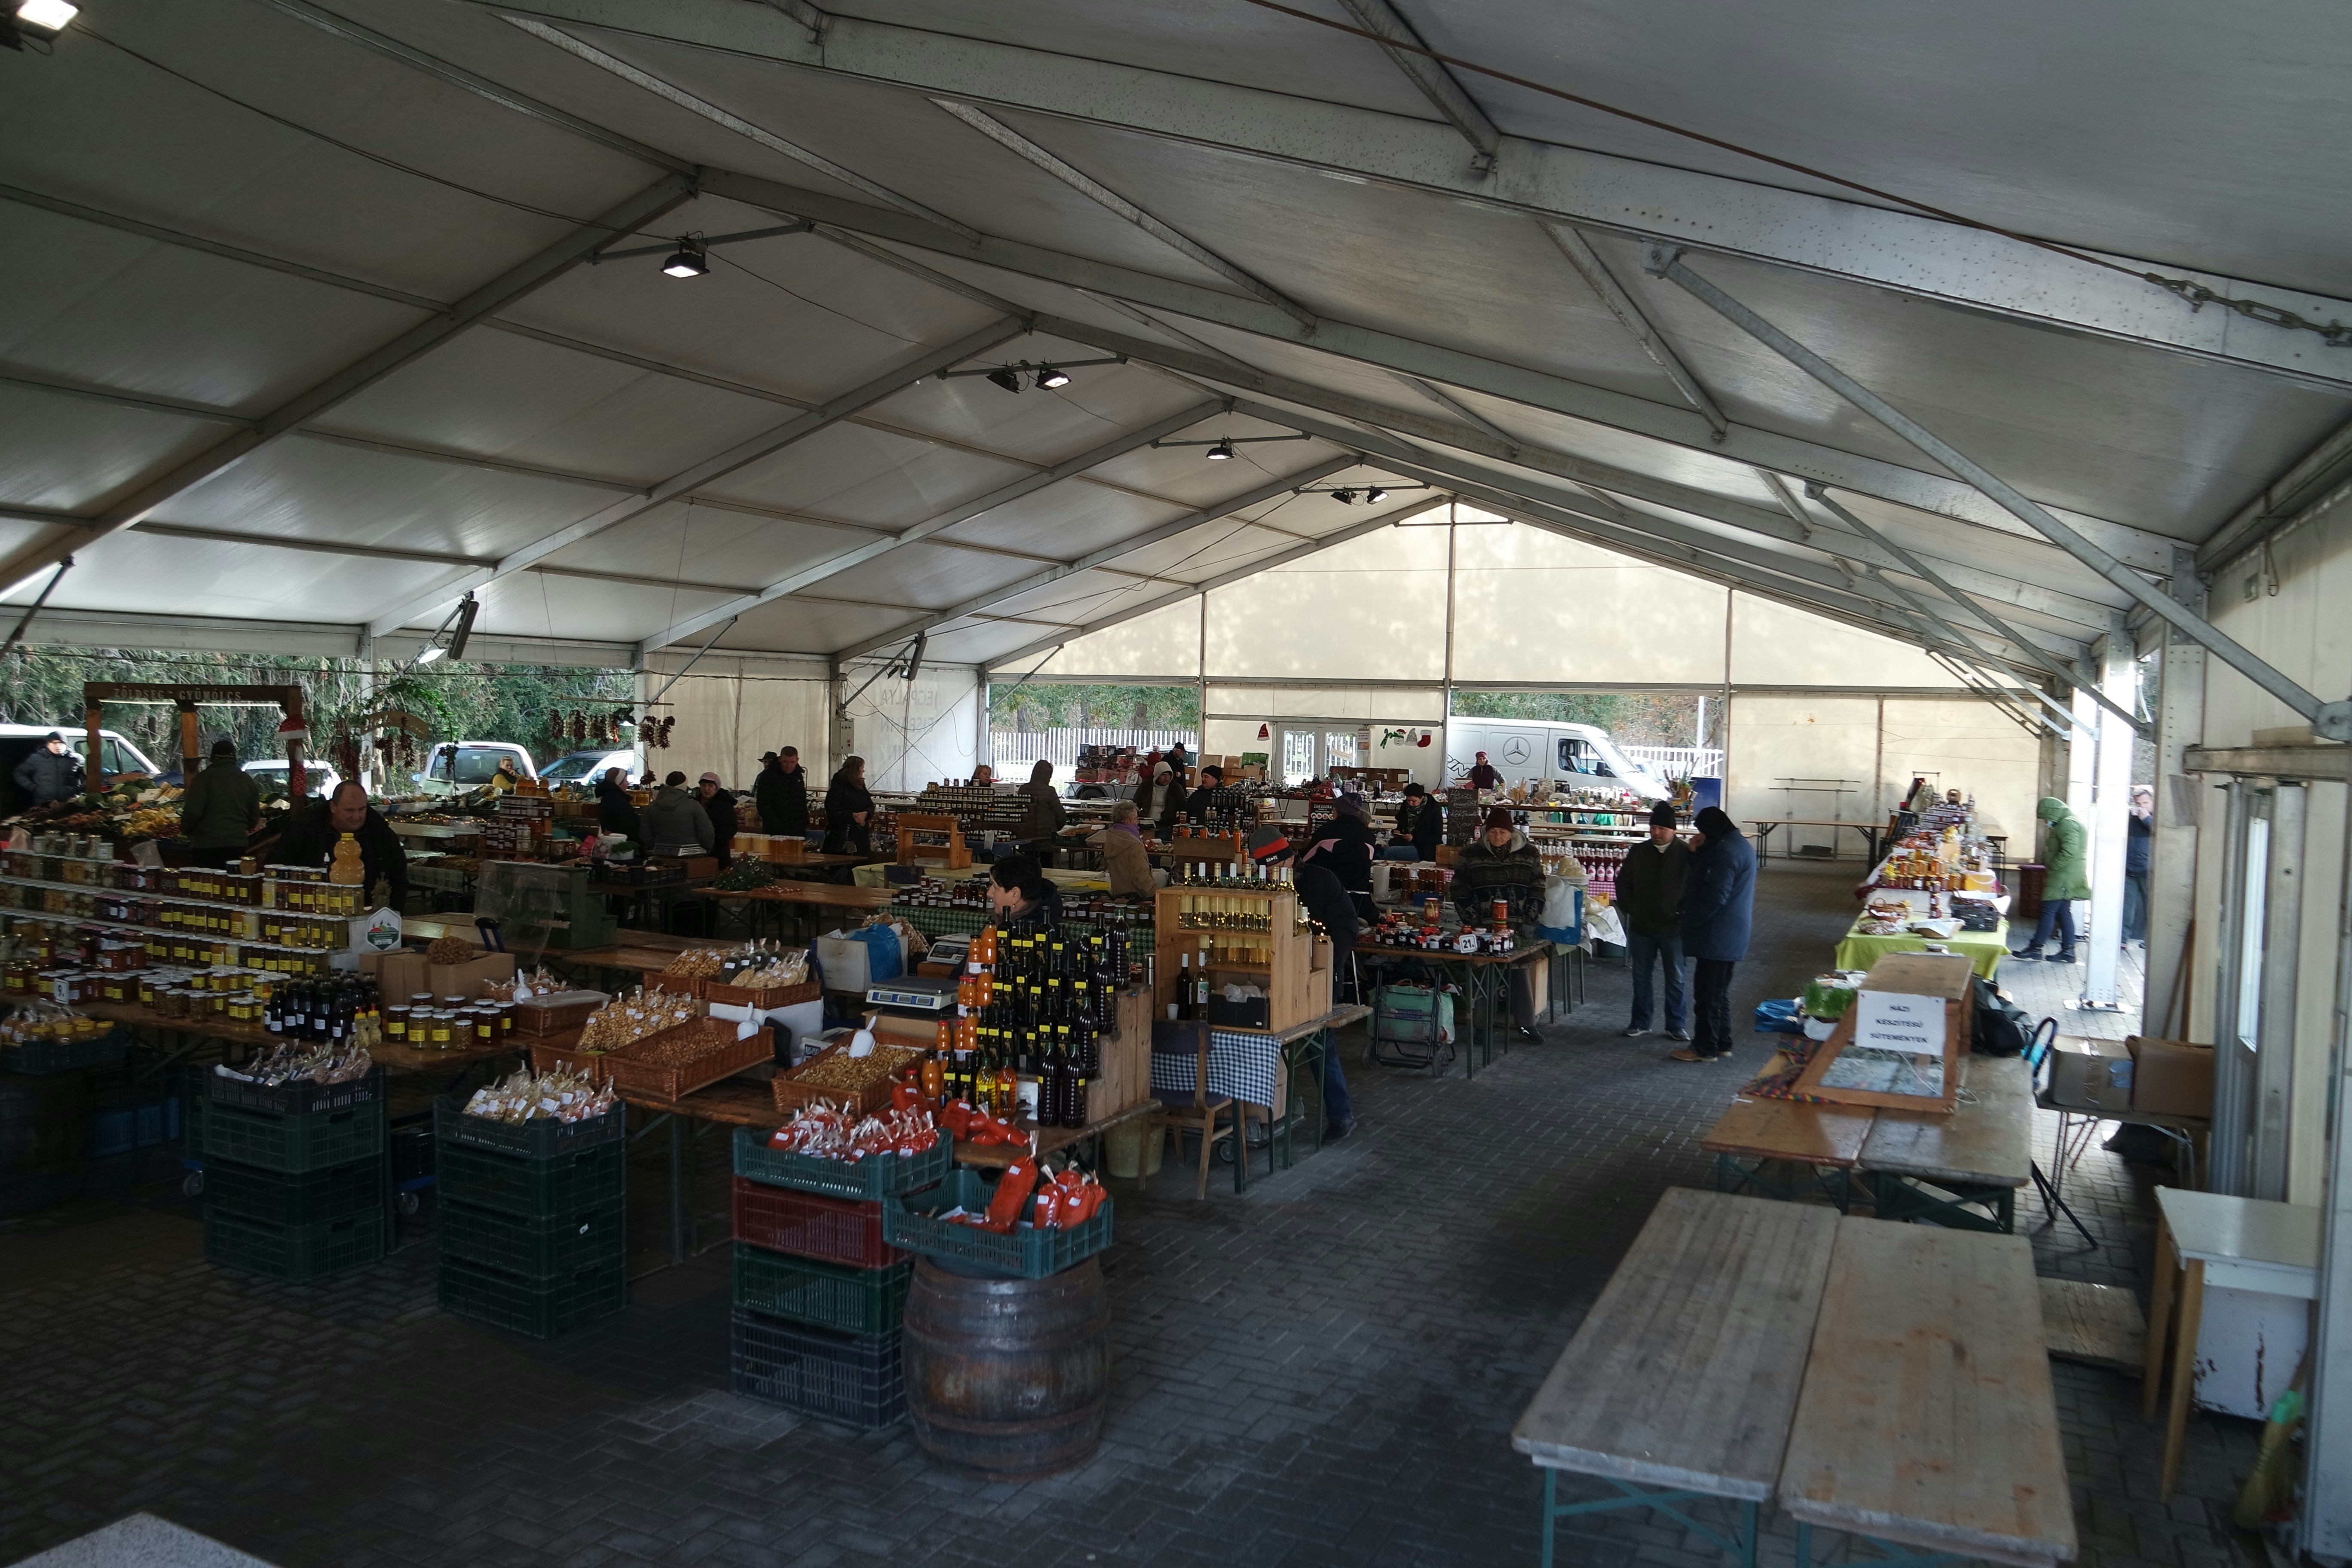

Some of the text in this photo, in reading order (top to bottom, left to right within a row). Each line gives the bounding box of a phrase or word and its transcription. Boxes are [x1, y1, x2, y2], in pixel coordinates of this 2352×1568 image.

[114, 686, 164, 699] ZÖLDSÉG
[1463, 939, 1474, 948] 21.
[58, 985, 64, 996] 9.
